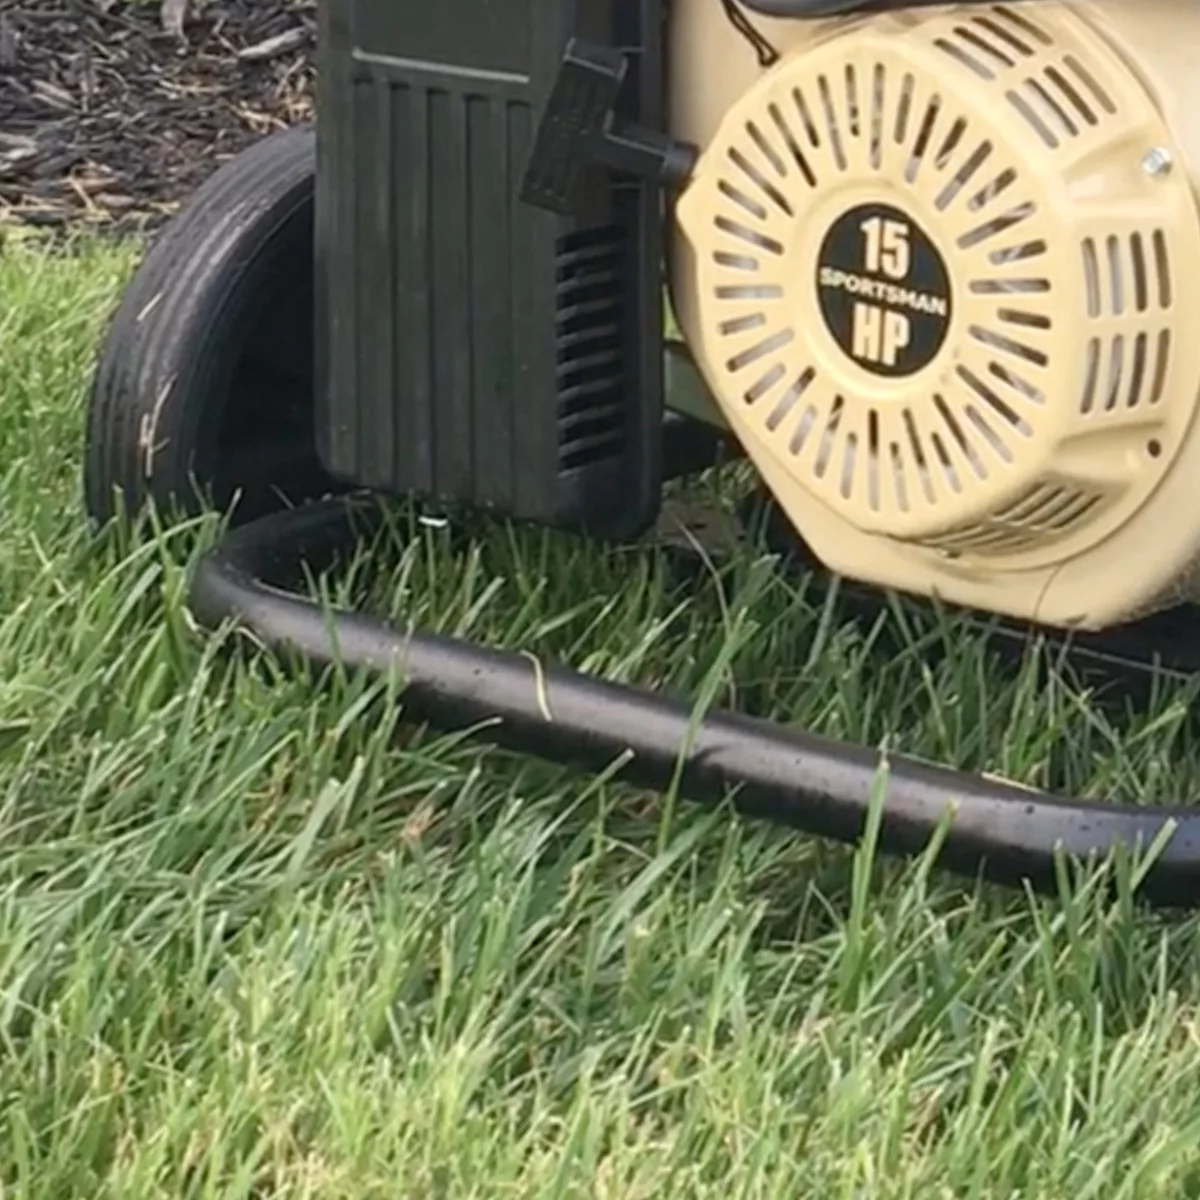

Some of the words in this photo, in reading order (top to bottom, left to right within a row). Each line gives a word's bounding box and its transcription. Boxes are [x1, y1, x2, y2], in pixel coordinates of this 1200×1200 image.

[860, 217, 910, 280] 15
[819, 266, 947, 316] SPORTSMAN
[852, 302, 910, 367] HP
